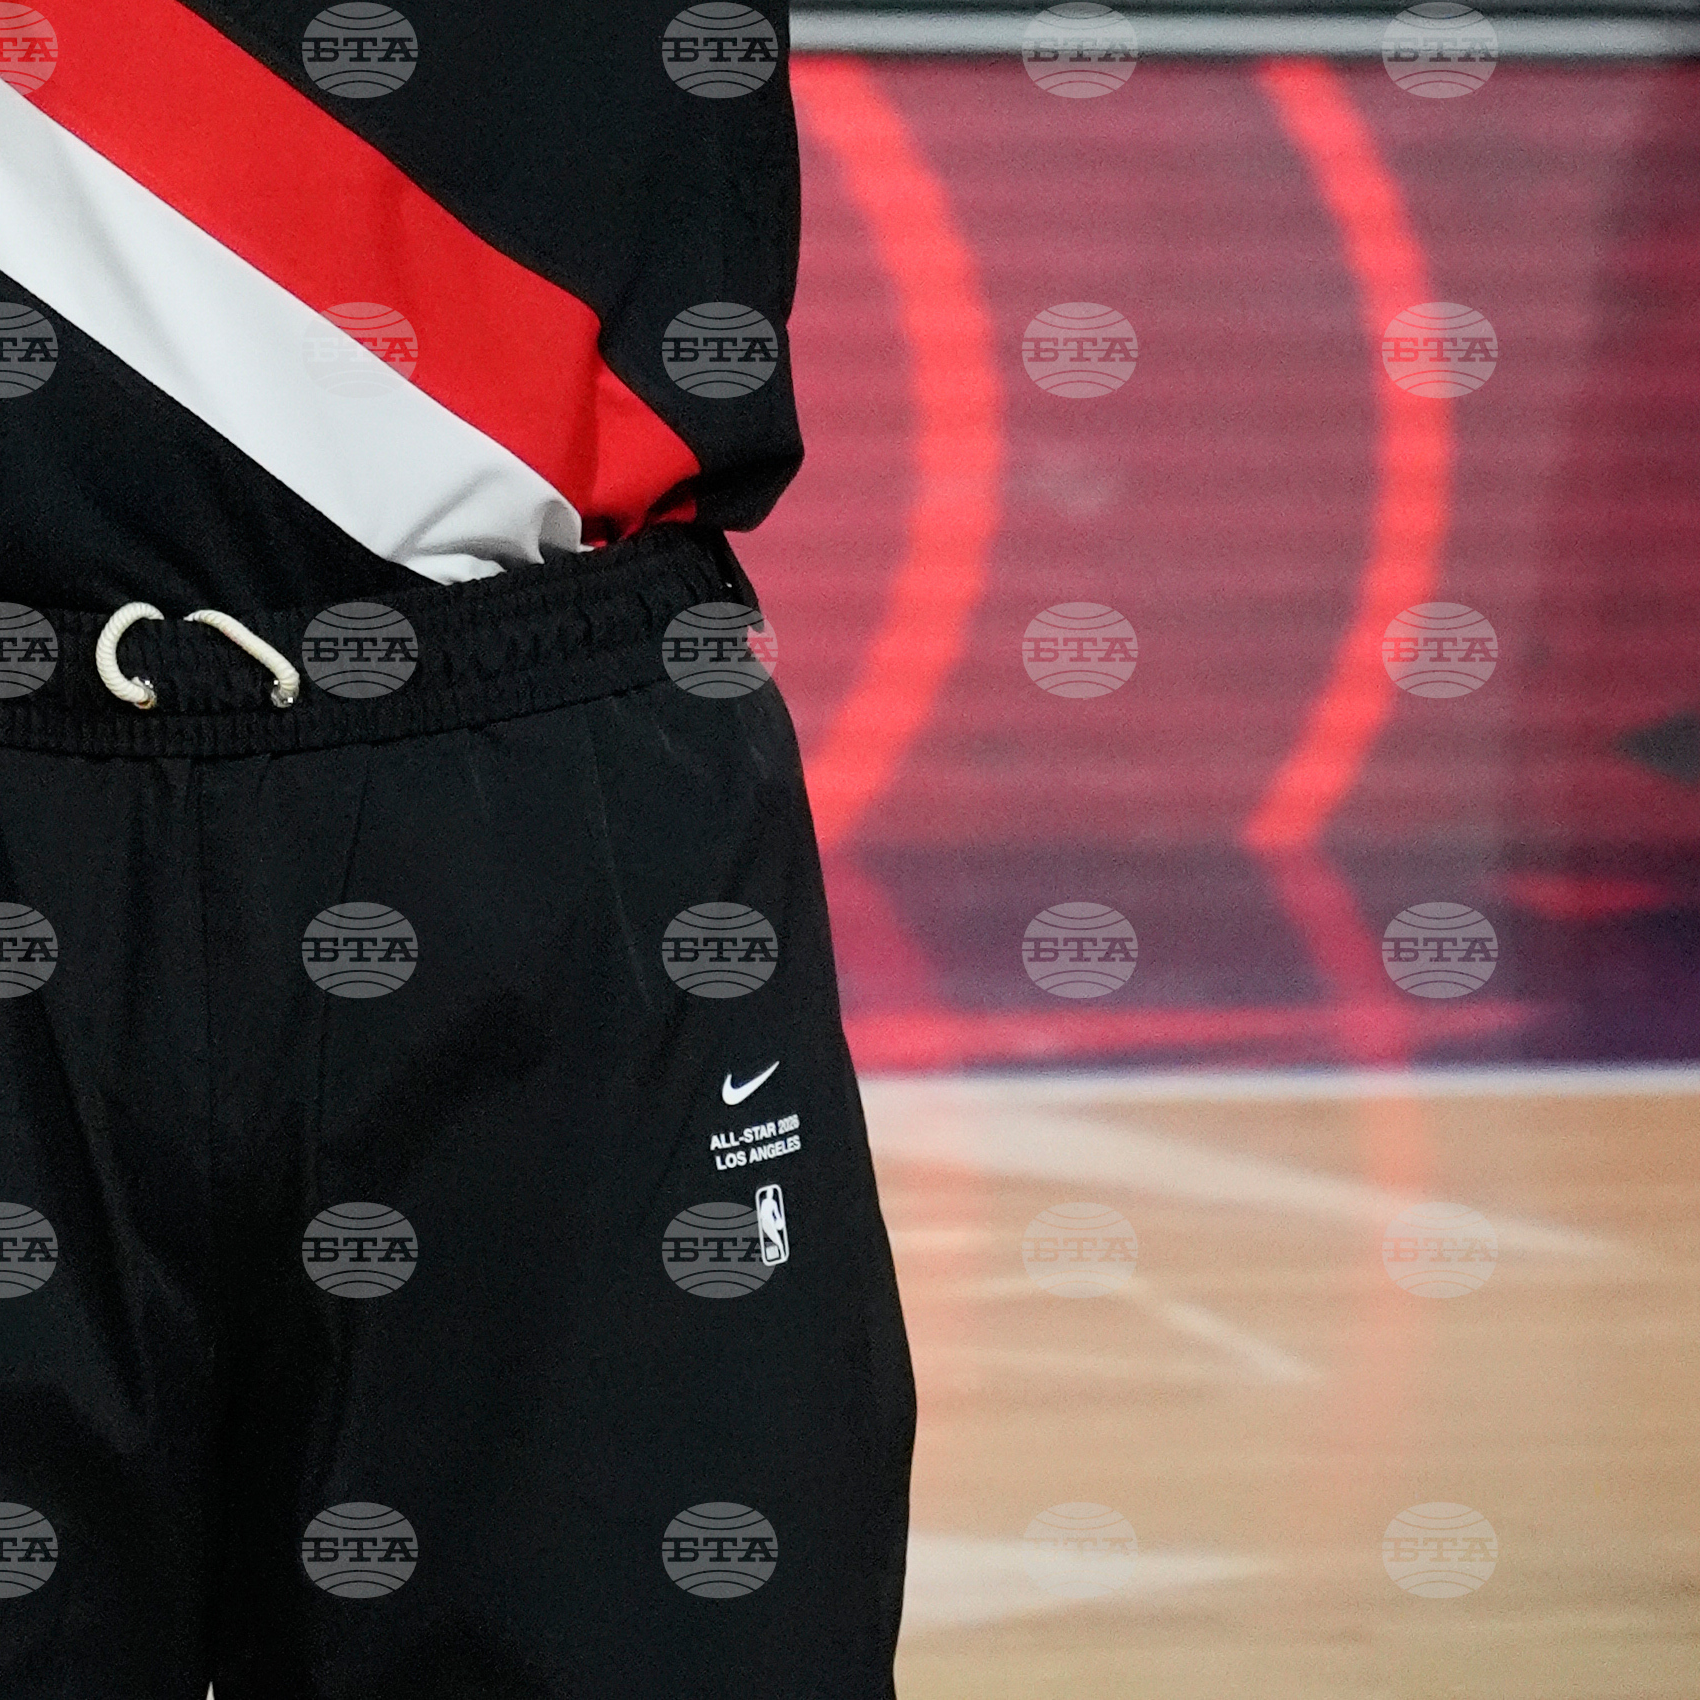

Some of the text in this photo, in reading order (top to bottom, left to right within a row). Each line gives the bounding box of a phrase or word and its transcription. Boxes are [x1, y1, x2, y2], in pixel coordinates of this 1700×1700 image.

[710, 1122, 777, 1151] ALL-STAR
[715, 1135, 801, 1171] LOS ANGELES
